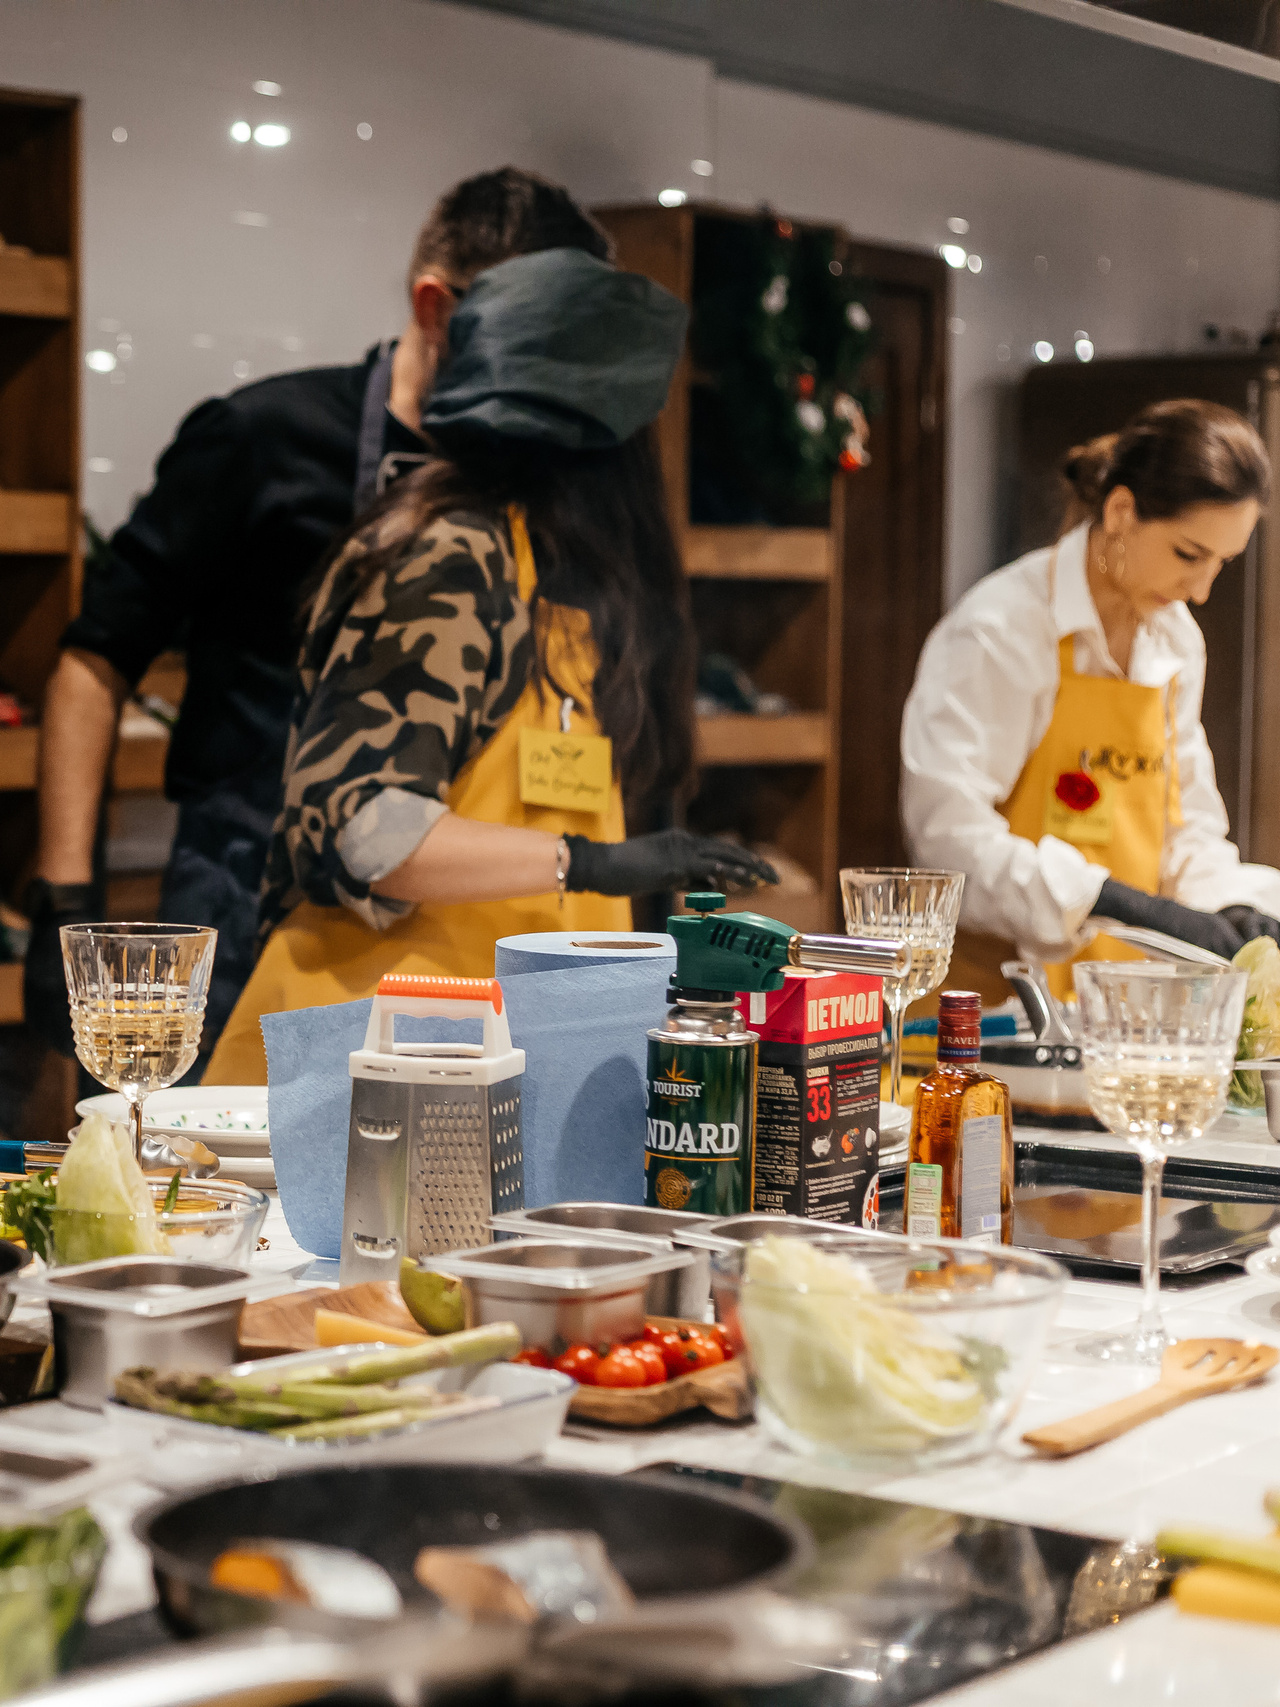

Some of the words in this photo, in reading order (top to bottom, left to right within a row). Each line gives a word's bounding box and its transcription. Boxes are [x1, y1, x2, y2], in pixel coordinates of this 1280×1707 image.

[807, 990, 879, 1033] ПЕТМОЛ
[808, 1045, 827, 1060] ВЫБОР
[827, 1036, 878, 1056] ПРОФЕССИОНАЛОВ
[942, 1035, 977, 1045] TRAVEL
[806, 1066, 829, 1079] СЛИВКИ
[653, 1080, 702, 1098] TOURIST
[806, 1085, 831, 1123] 33
[645, 1117, 740, 1154] NDARD
